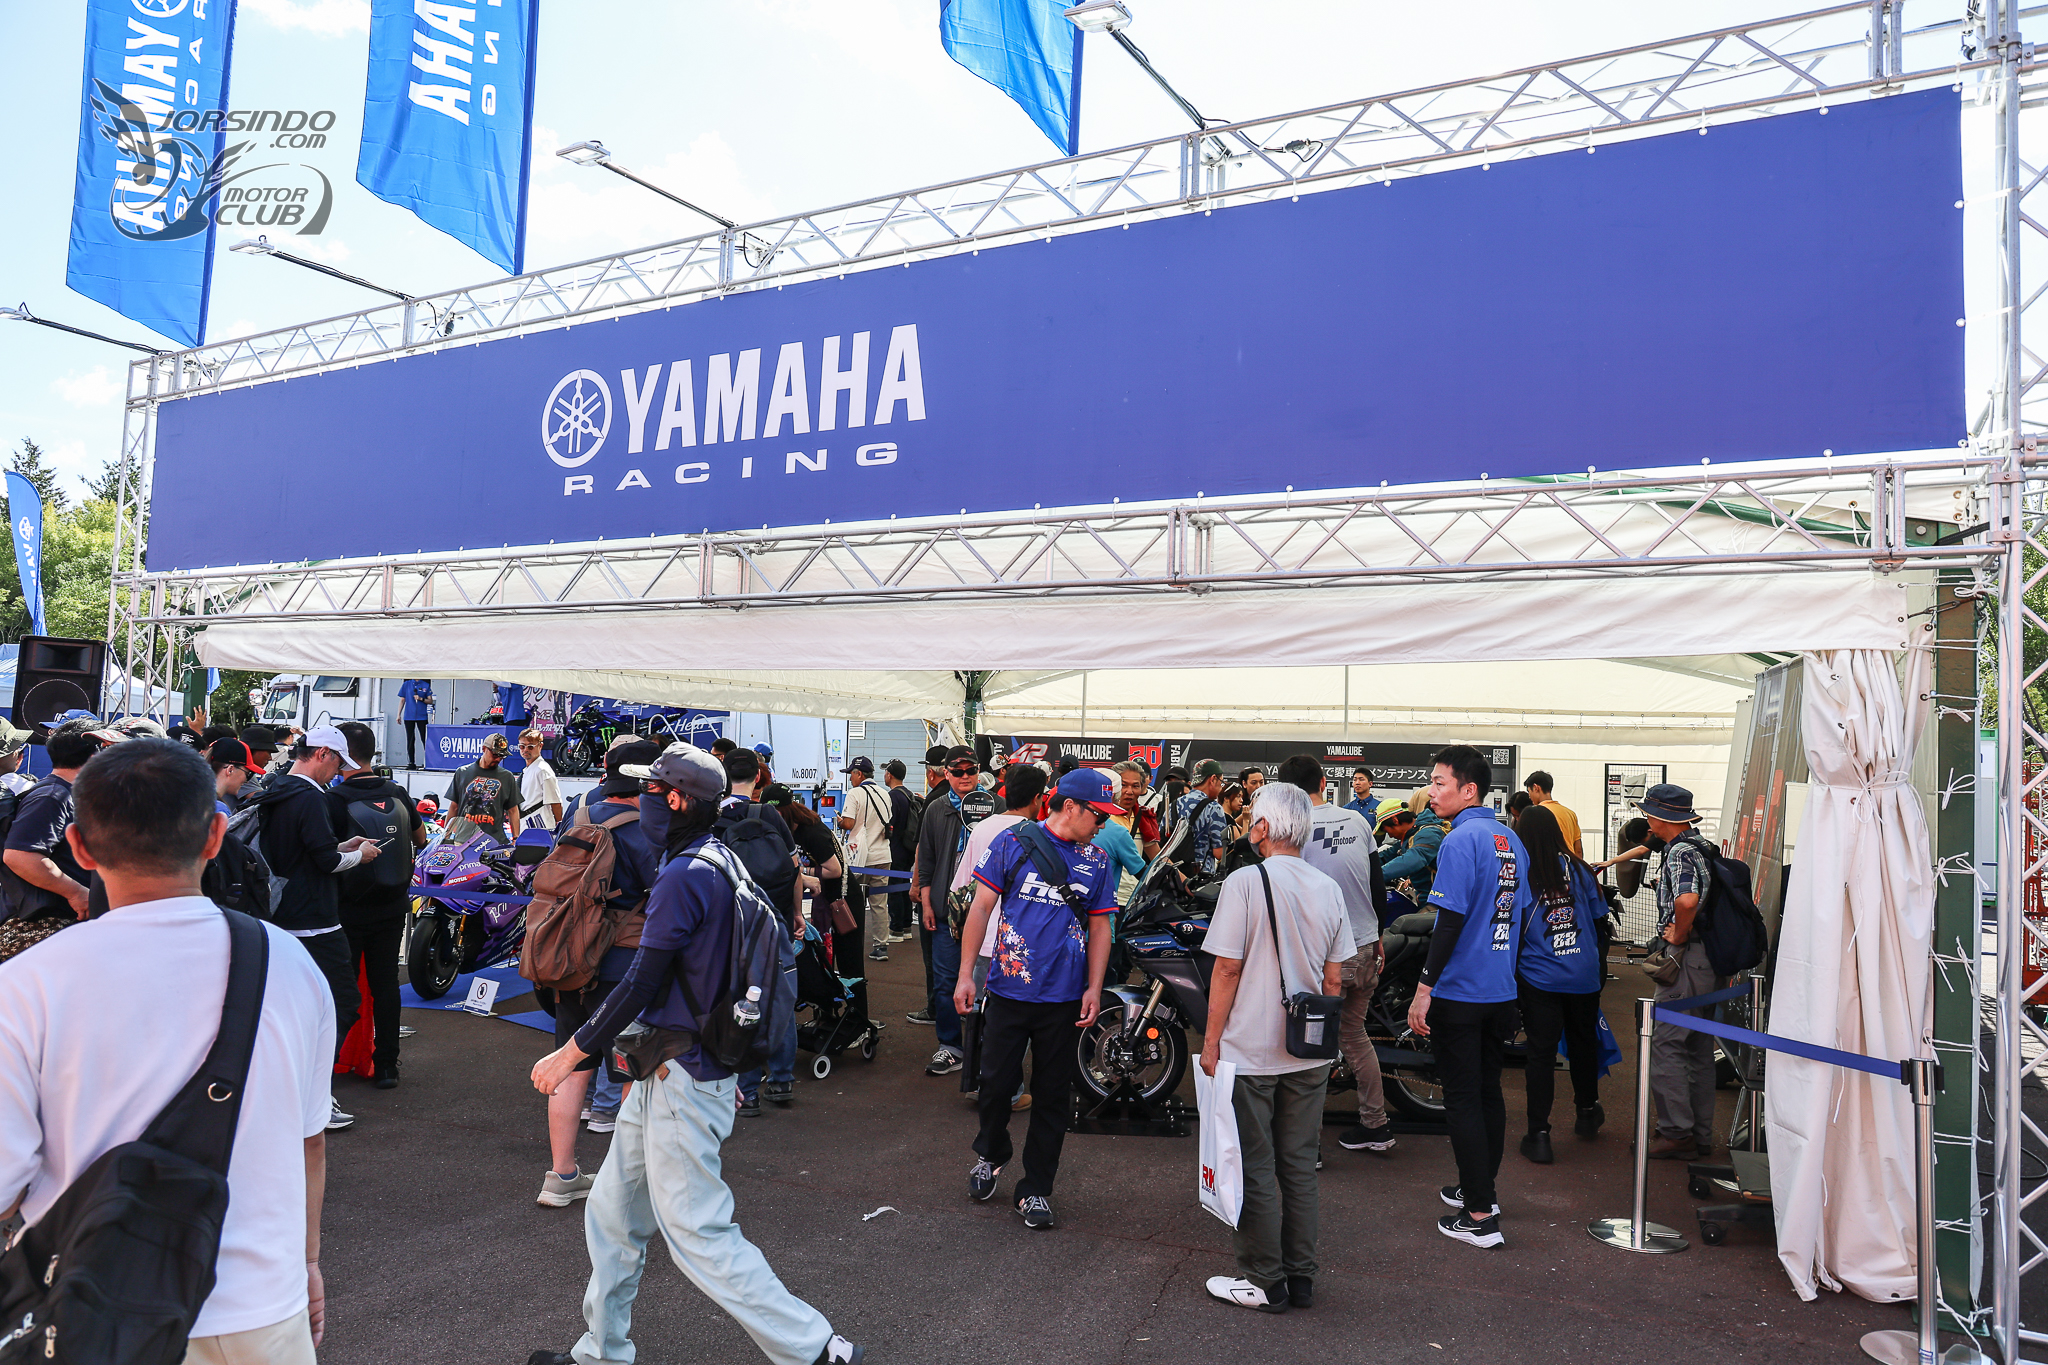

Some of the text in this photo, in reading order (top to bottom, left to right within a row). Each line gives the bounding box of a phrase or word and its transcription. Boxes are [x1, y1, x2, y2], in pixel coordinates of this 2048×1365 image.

[620, 323, 927, 454] YAMAHA
[563, 441, 898, 496] RACING
[451, 738, 483, 754] YAMAH
[1009, 743, 1049, 764] 42
[1059, 743, 1112, 761] YAMALUBE
[1326, 745, 1363, 756] YAMALUBE
[1128, 742, 1163, 770] 20
[791, 768, 817, 780] No.8007
[1498, 862, 1516, 880] 42
[1018, 893, 1048, 904] Honda
[1546, 905, 1574, 925] 43
